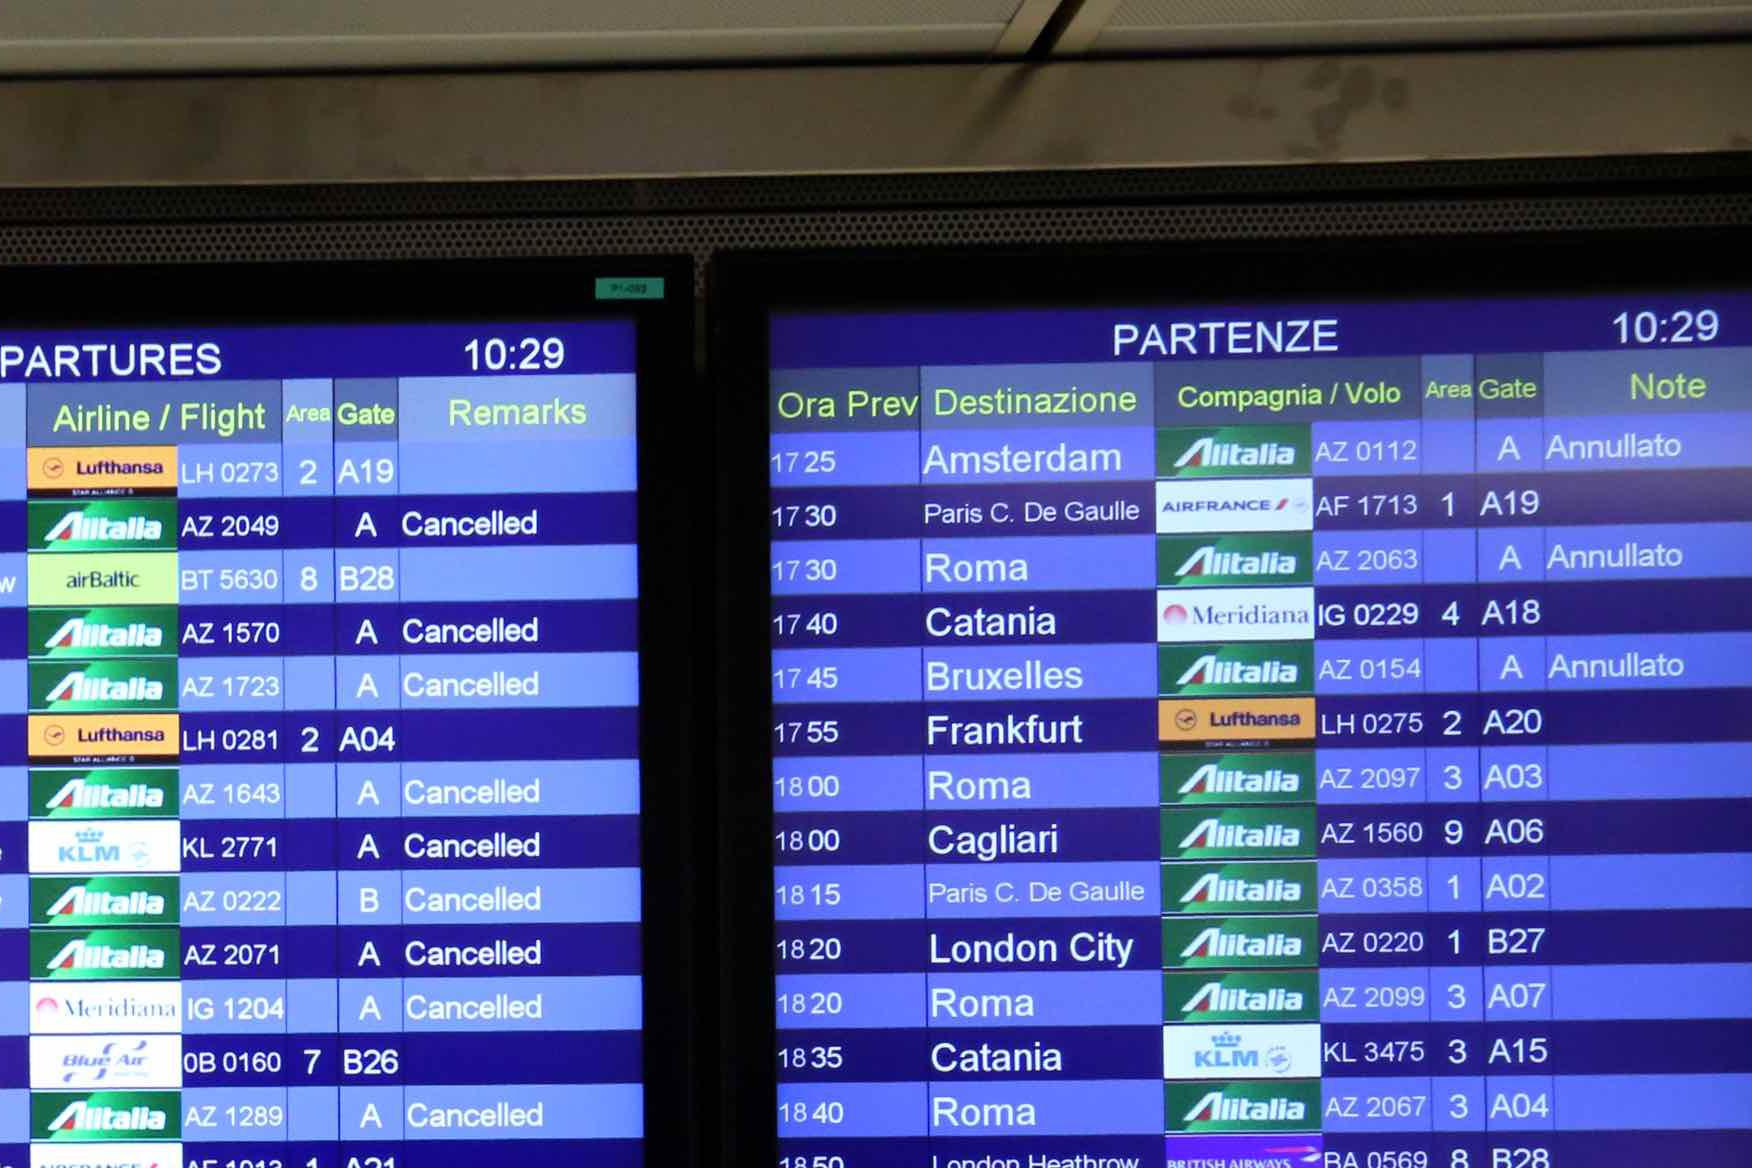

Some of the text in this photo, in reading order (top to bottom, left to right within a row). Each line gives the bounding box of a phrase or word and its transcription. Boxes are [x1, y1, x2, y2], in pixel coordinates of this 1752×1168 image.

[1114, 319, 1339, 356] PARTENZE
[1613, 309, 1719, 344] 10:29
[464, 337, 565, 371] 10:29
[1177, 381, 1401, 413] Compagnia / Volo
[1424, 380, 1473, 399] Area
[1478, 378, 1537, 400] Gate
[1630, 373, 1707, 400] Note
[285, 404, 331, 423] Area
[336, 402, 396, 425] Gate
[449, 397, 587, 427] Remarks
[778, 390, 919, 419] Ora Prev
[935, 386, 1137, 416] Destinazione
[52, 402, 266, 437] Airline / Flight
[925, 442, 1122, 475] Amsterdam
[1174, 438, 1295, 468] Alitalia
[1545, 433, 1682, 460] Annullato
[76, 460, 164, 475] Lufthansa
[181, 461, 279, 484] LH 0273
[1315, 494, 1418, 517] AF 1713
[402, 509, 538, 537] Cancelled
[66, 570, 141, 589] airBaltic
[927, 605, 1056, 637] Catania
[1192, 605, 1310, 625] Meridiana
[1482, 599, 1541, 625] A18
[338, 726, 396, 752] A04
[929, 714, 1083, 745] Frankfurt
[932, 931, 1134, 969] London City
[1488, 927, 1546, 955] B27
[222, 1051, 282, 1073] 0160
[344, 1048, 399, 1075] B26
[407, 1101, 544, 1128] Cancelled
